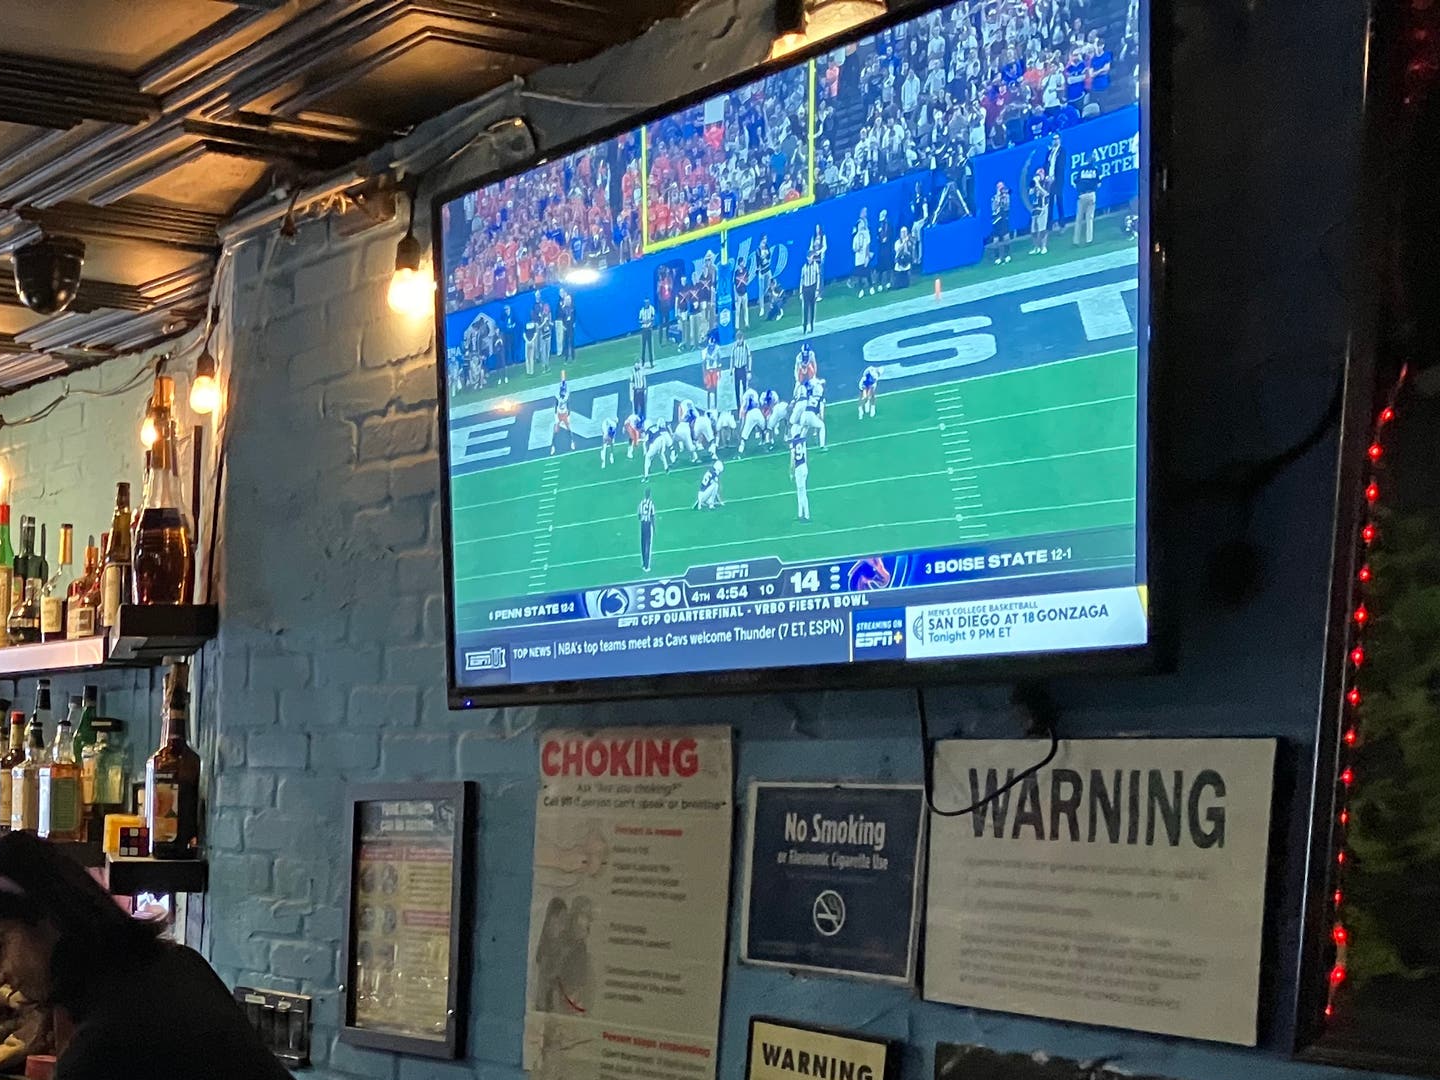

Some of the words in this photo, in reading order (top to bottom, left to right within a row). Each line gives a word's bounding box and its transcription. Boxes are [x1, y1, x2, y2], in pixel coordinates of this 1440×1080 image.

[716, 564, 749, 580] ESPN
[925, 563, 932, 575] 3
[934, 556, 985, 574] BOISE
[988, 550, 1048, 568] STATE
[1050, 548, 1072, 561] 12-1
[716, 586, 748, 600] 4:54
[760, 584, 774, 595] 10
[790, 570, 820, 593] 14
[650, 586, 681, 608] 30
[494, 608, 523, 620] PENN
[524, 603, 559, 618] STATE
[617, 616, 639, 628] ESPN
[641, 614, 660, 626] CFP
[664, 606, 744, 624] QUARTERFINAL
[754, 601, 785, 615] VRBO
[789, 597, 830, 612] FIESTA
[834, 594, 869, 608] BOWL
[928, 608, 951, 617] MEN'S
[952, 605, 986, 615] COLLEGE
[988, 601, 1038, 612] BASKETBALL
[928, 617, 954, 630] SAN
[958, 613, 1000, 628] DIEGO
[1004, 613, 1019, 625] AT
[1023, 612, 1035, 624] 18
[1037, 604, 1109, 622] GONZAGA
[856, 620, 892, 631] STREAMING
[928, 630, 966, 644] Tonight
[969, 629, 975, 640] 9
[979, 629, 995, 640] PM
[999, 626, 1012, 638] ET
[513, 648, 528, 660] TOP
[529, 646, 551, 658] NEWS
[558, 642, 582, 655] NBA's
[583, 641, 598, 656] top
[600, 638, 626, 652] teams
[628, 637, 652, 649] meet
[653, 637, 664, 647] as
[665, 633, 688, 646] Cavs
[690, 630, 732, 645] welcome
[734, 625, 775, 641] Thunder
[778, 623, 789, 640] (7
[809, 618, 844, 636] ESPN)
[542, 738, 699, 777] CHOKING
[968, 767, 1227, 850] WARNING
[785, 812, 807, 842] No
[811, 813, 886, 851] Smoking
